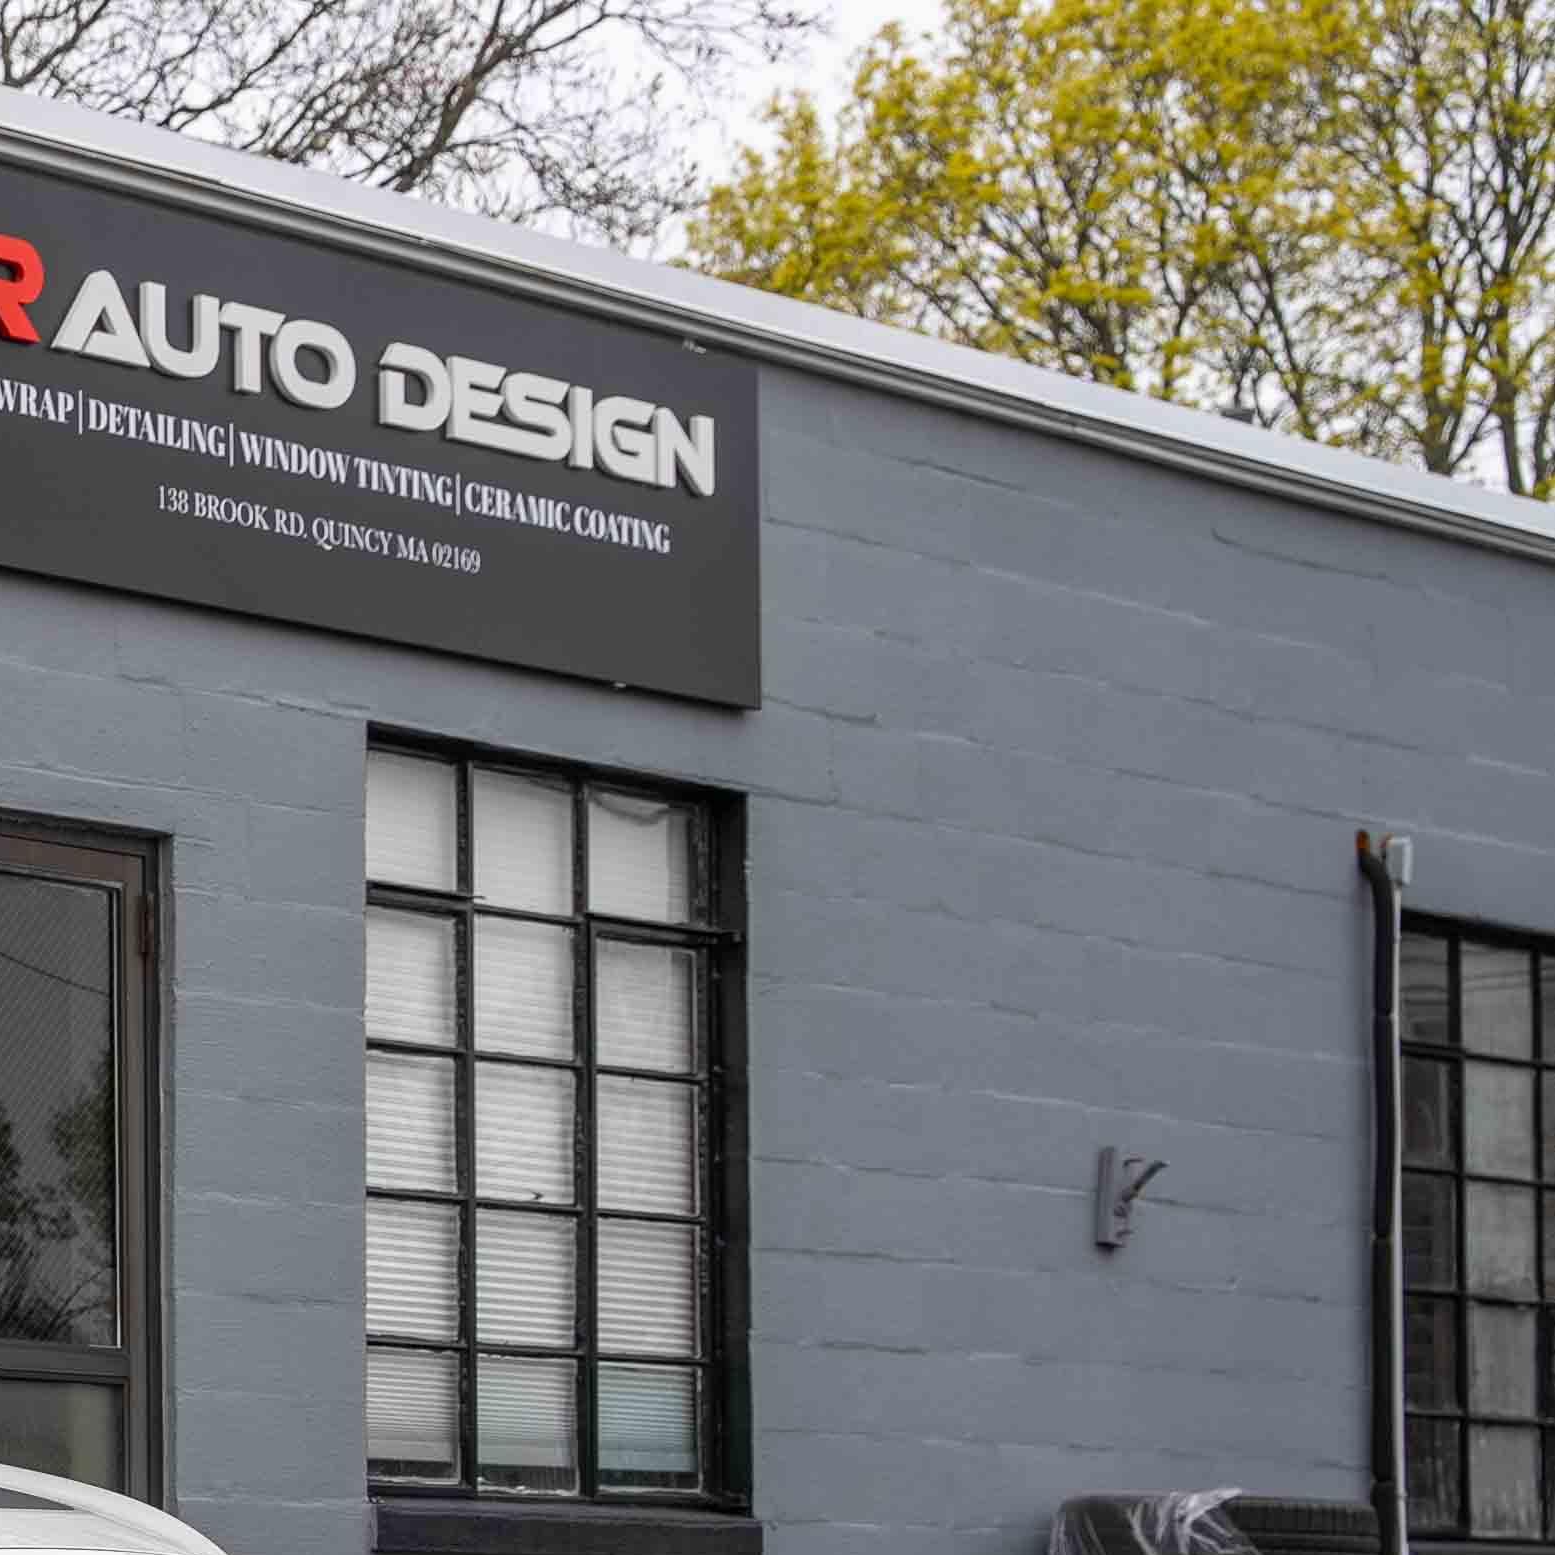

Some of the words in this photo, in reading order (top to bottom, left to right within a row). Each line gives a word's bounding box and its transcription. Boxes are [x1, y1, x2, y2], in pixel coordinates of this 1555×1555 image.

[50, 269, 357, 410] AUTO
[378, 341, 716, 497] DESIGN
[89, 397, 227, 458] DETAILING
[239, 430, 351, 485] WINDOW
[353, 455, 454, 507] TINTING
[464, 479, 571, 533] CERAMIC
[573, 504, 672, 554] COATING
[157, 484, 190, 515] 138
[193, 491, 271, 531] BROOK
[273, 507, 308, 540] RD.
[311, 516, 394, 555] QUINCY
[396, 533, 430, 564] MA
[431, 541, 483, 575] 02169
